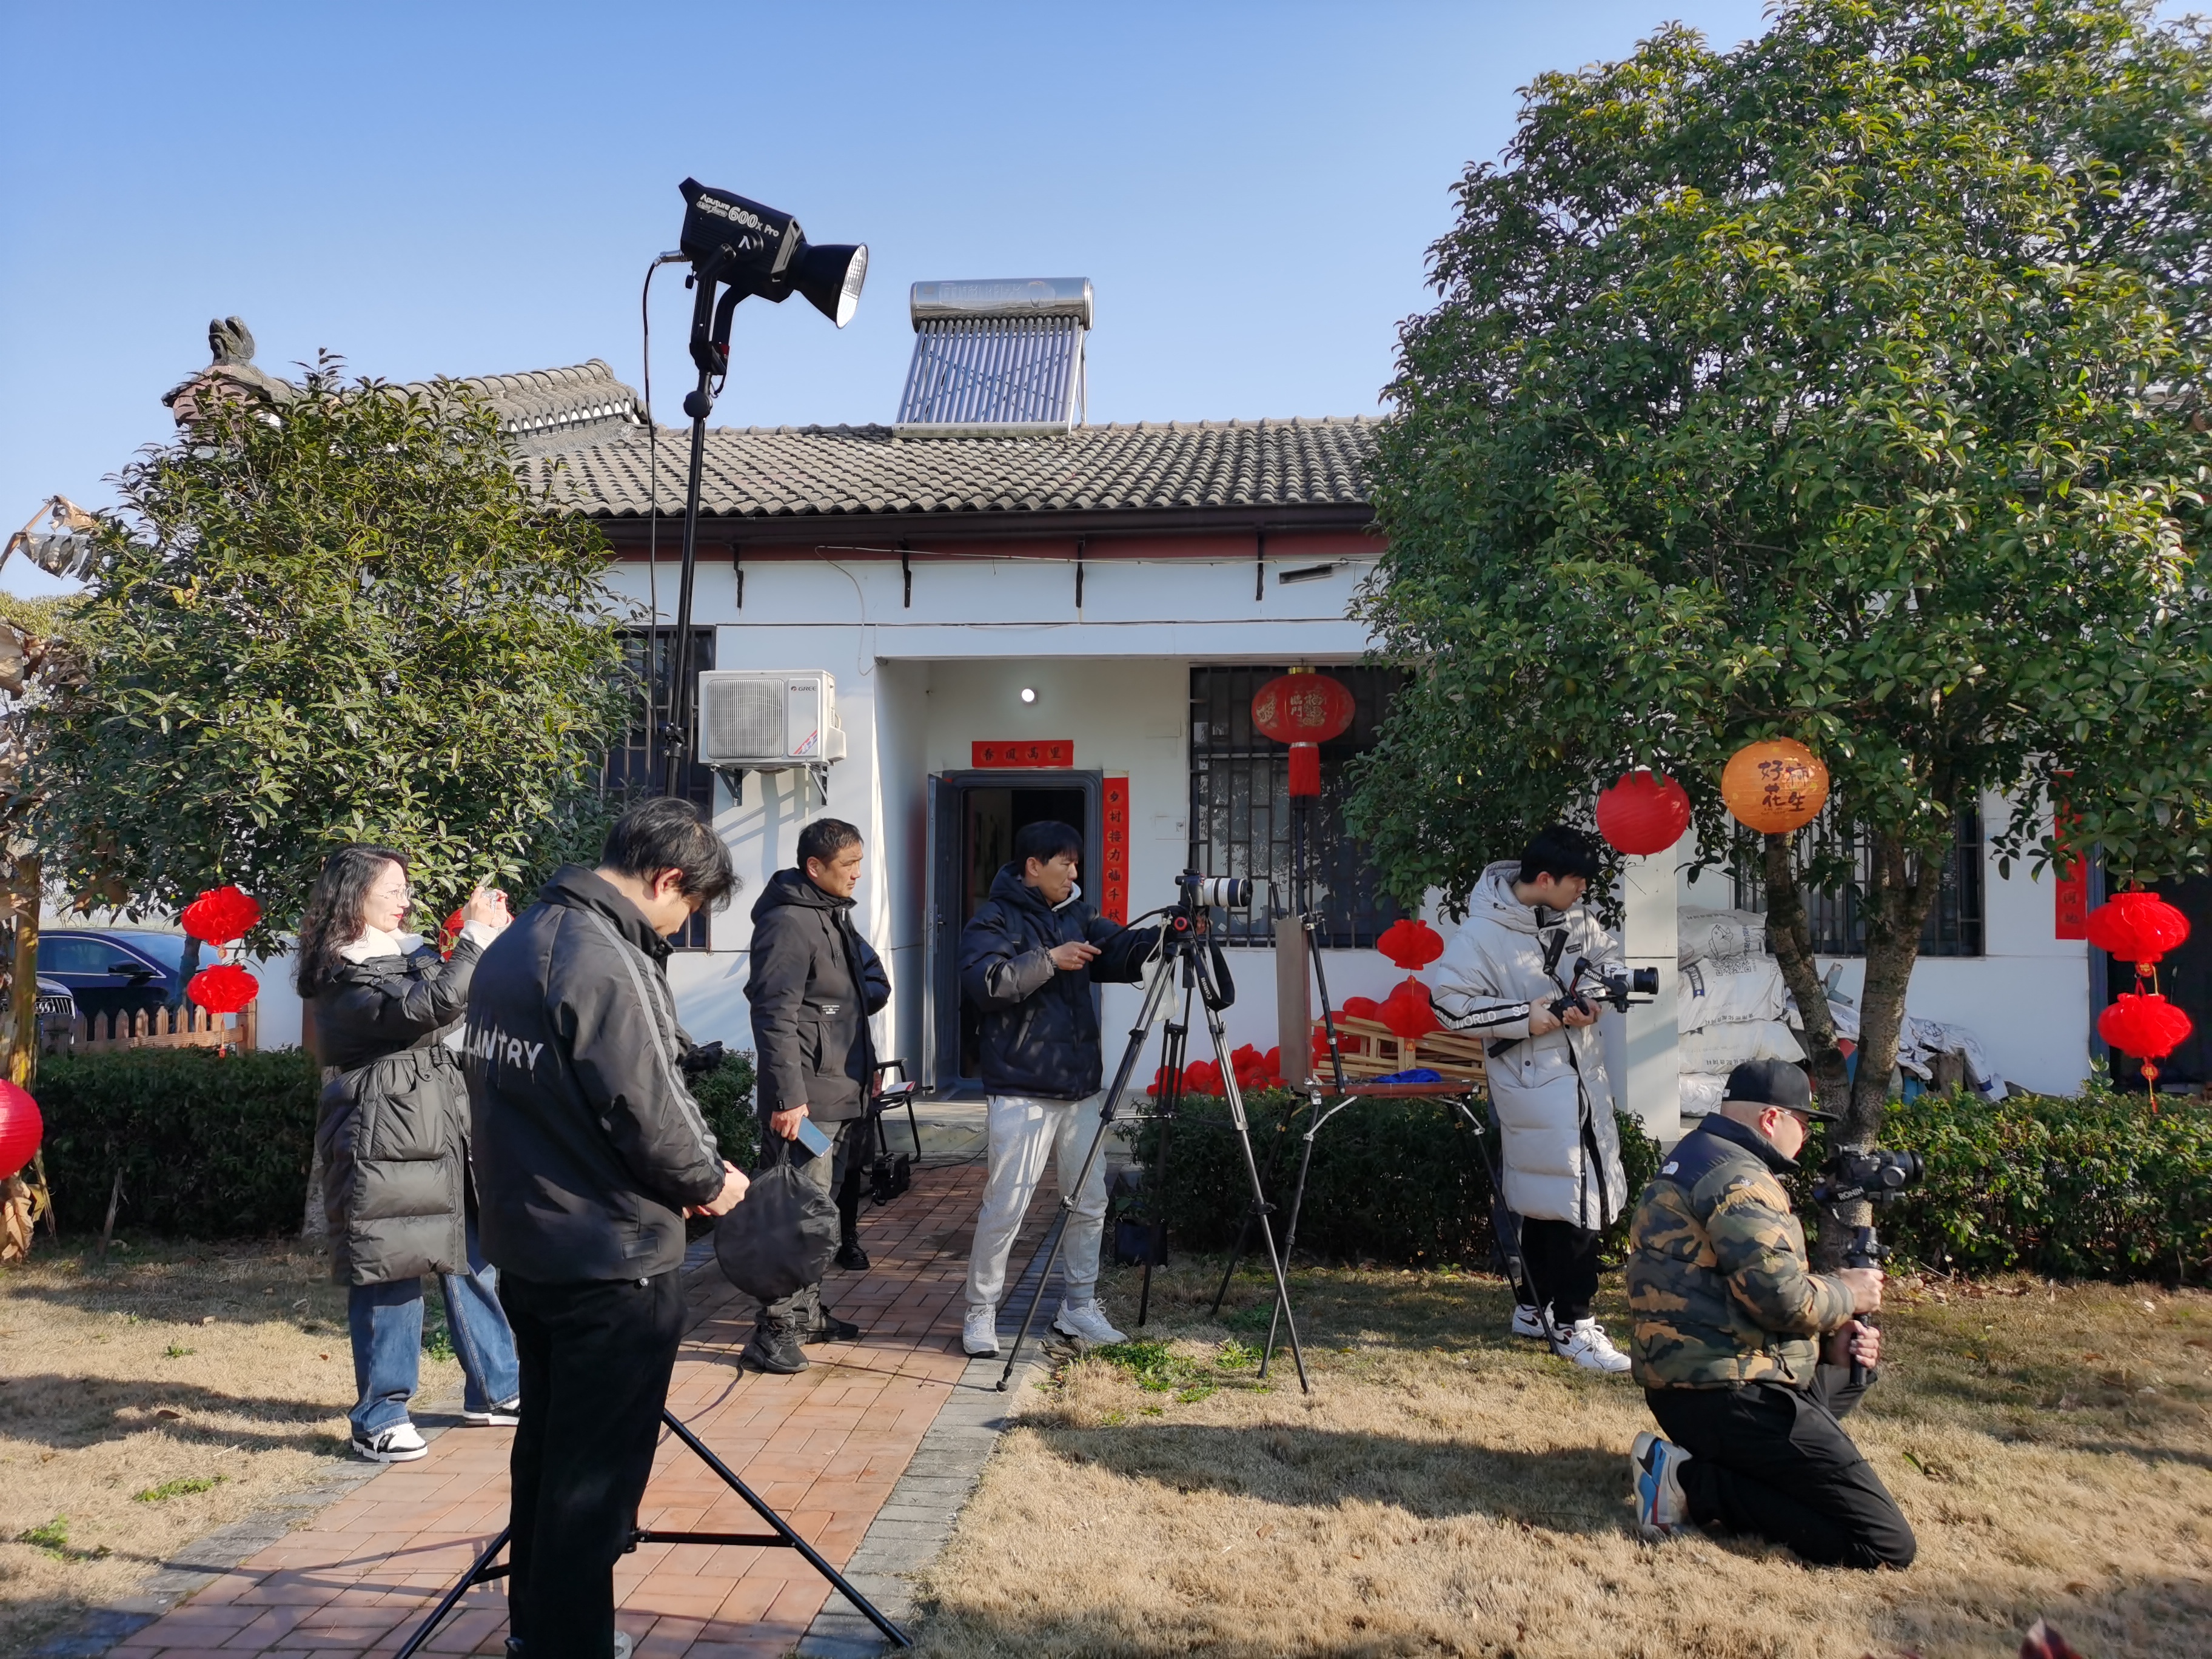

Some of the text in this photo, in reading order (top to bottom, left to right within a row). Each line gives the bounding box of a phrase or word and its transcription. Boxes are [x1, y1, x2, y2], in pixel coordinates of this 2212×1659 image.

[700, 193, 731, 210] Aputure
[764, 224, 780, 238] Pro
[1761, 782, 1806, 812] 花生
[1584, 968, 1602, 982] RONIN
[1201, 977, 1213, 1000] Canon
[1455, 1010, 1497, 1030] WORLD
[1837, 1185, 1865, 1201] RONIN
